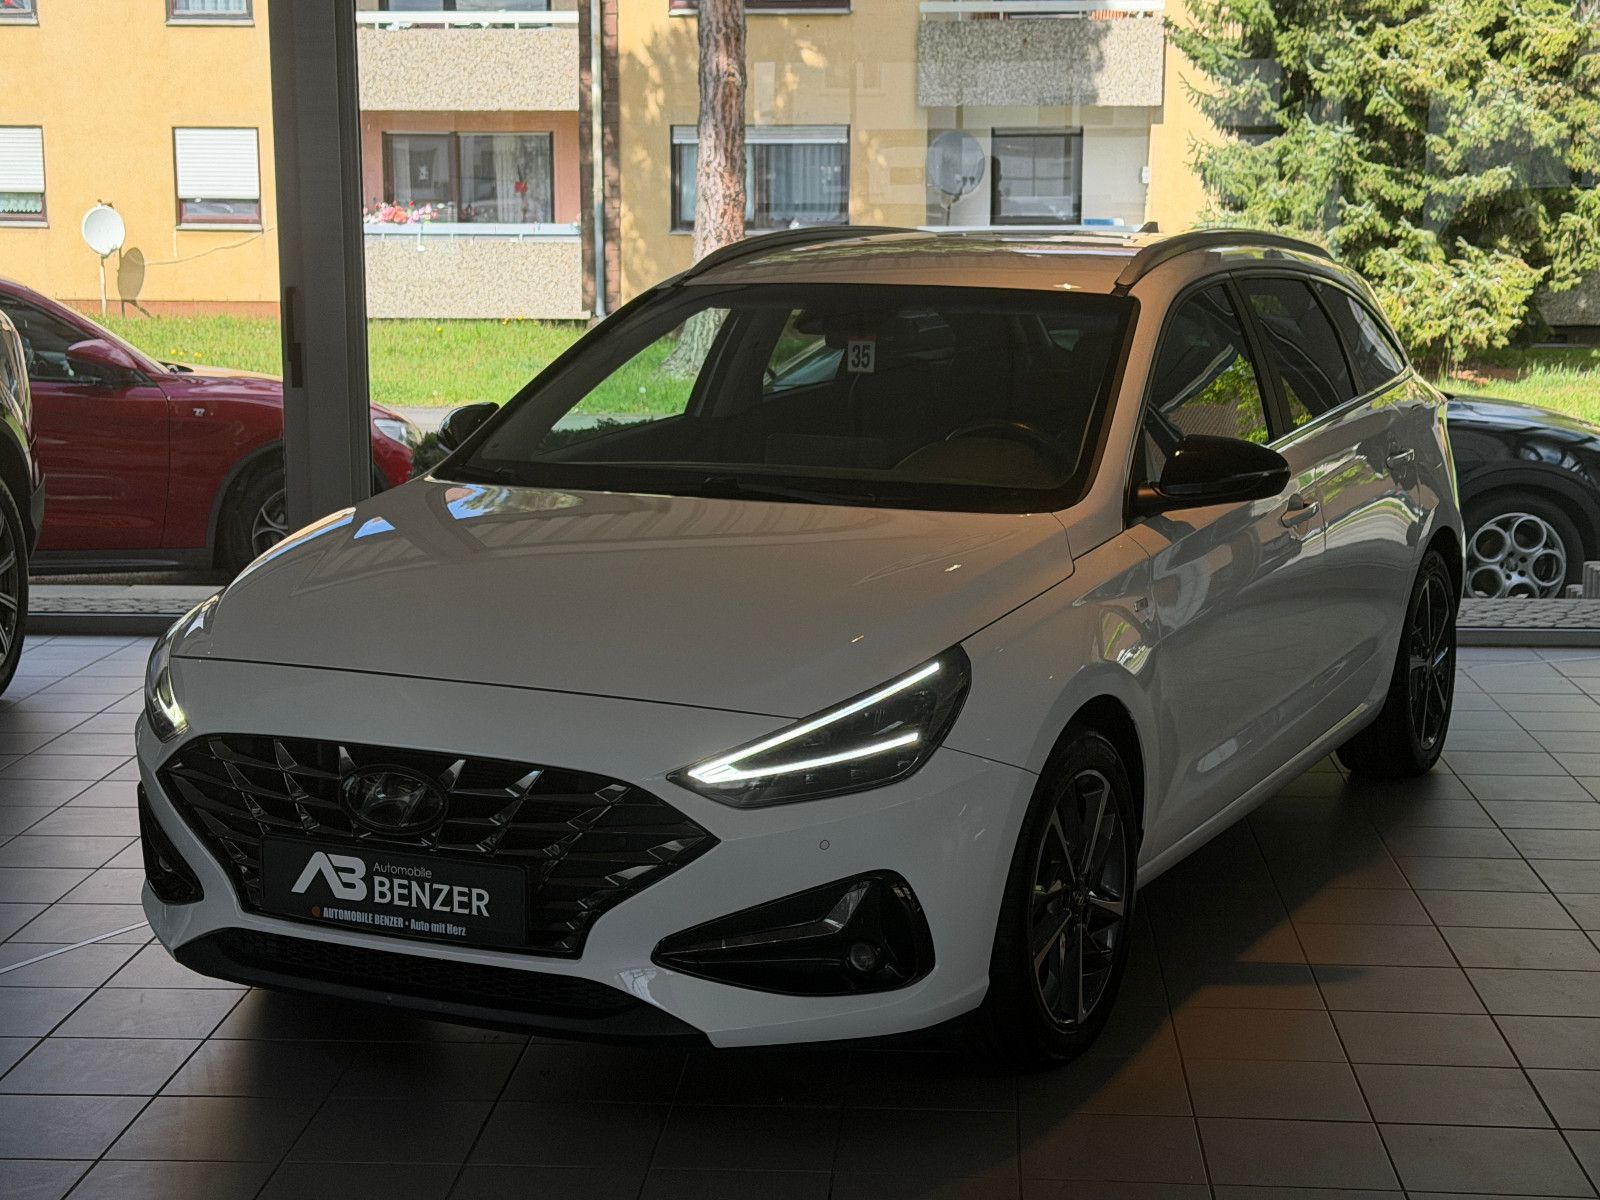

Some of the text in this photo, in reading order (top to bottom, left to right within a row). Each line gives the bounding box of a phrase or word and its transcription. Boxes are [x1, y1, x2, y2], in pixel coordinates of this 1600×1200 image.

[851, 344, 871, 369] 35
[290, 851, 367, 901] AB
[373, 862, 433, 880] Automobile
[373, 875, 490, 918] BENZER
[323, 906, 467, 937] AUTOMOBILE BENZER Auto mit Herz
